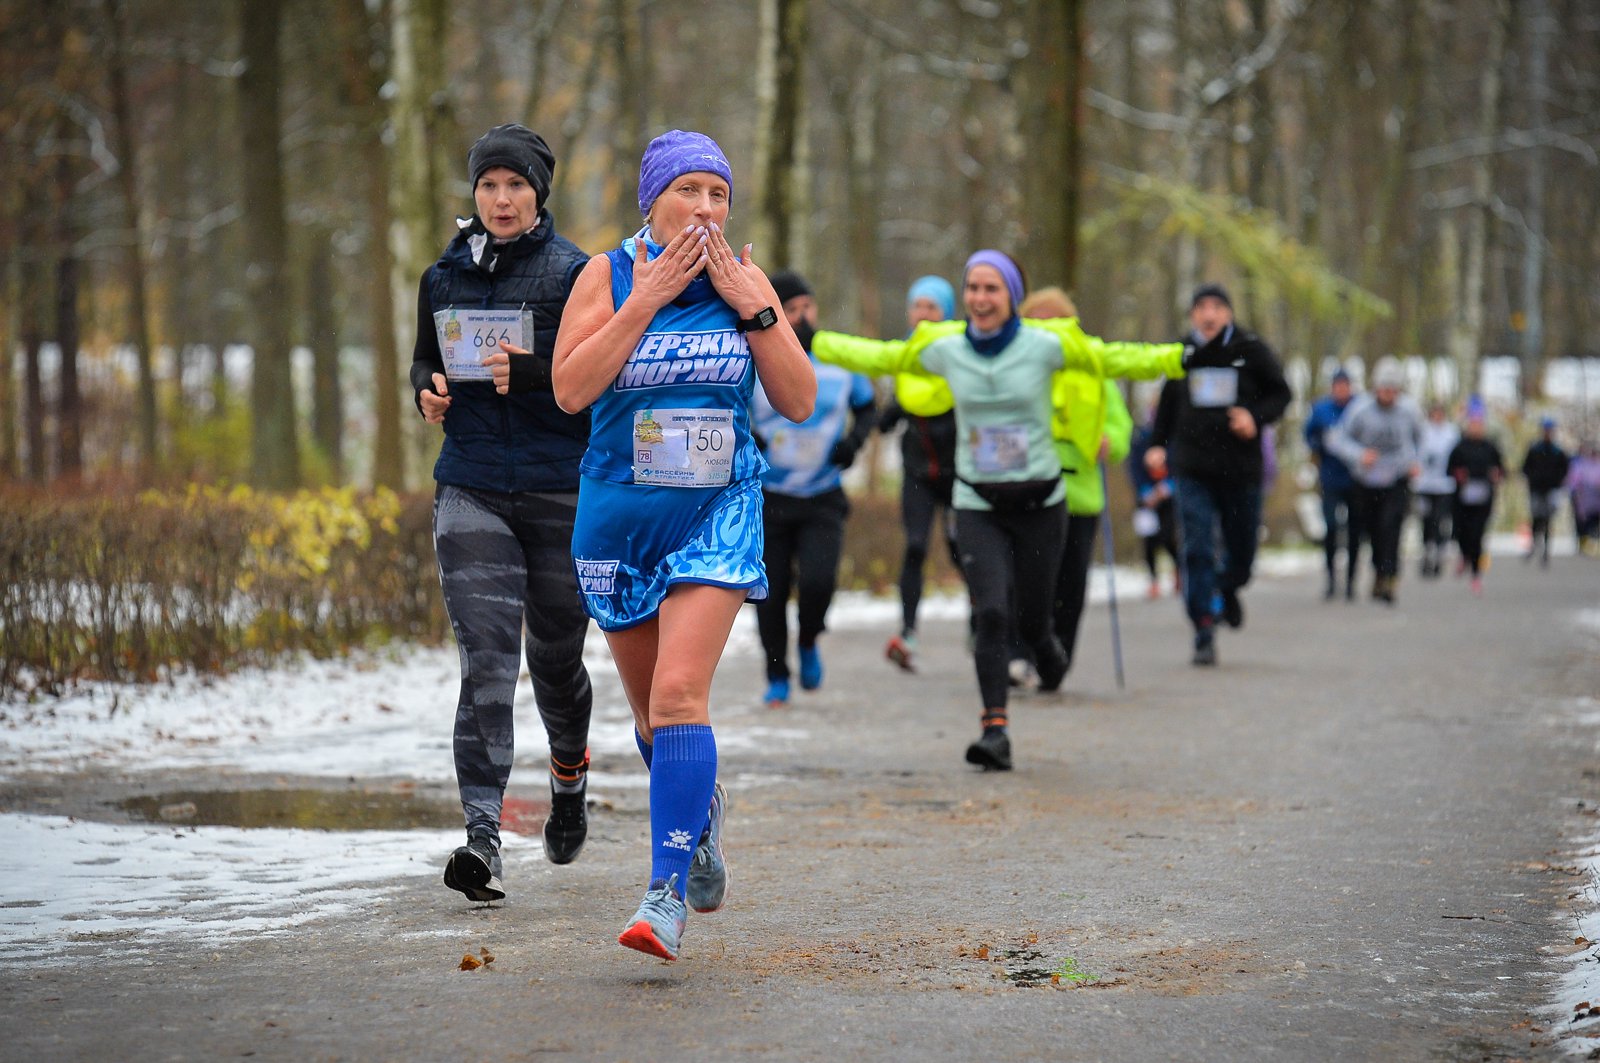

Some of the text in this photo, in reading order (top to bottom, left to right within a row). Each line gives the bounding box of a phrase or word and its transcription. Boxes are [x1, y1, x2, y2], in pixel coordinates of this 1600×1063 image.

[473, 328, 511, 348] 666
[617, 356, 746, 388] МОРЖИ
[684, 428, 723, 452] 150
[579, 577, 611, 592] РЖИ
[662, 840, 692, 852] KELME
